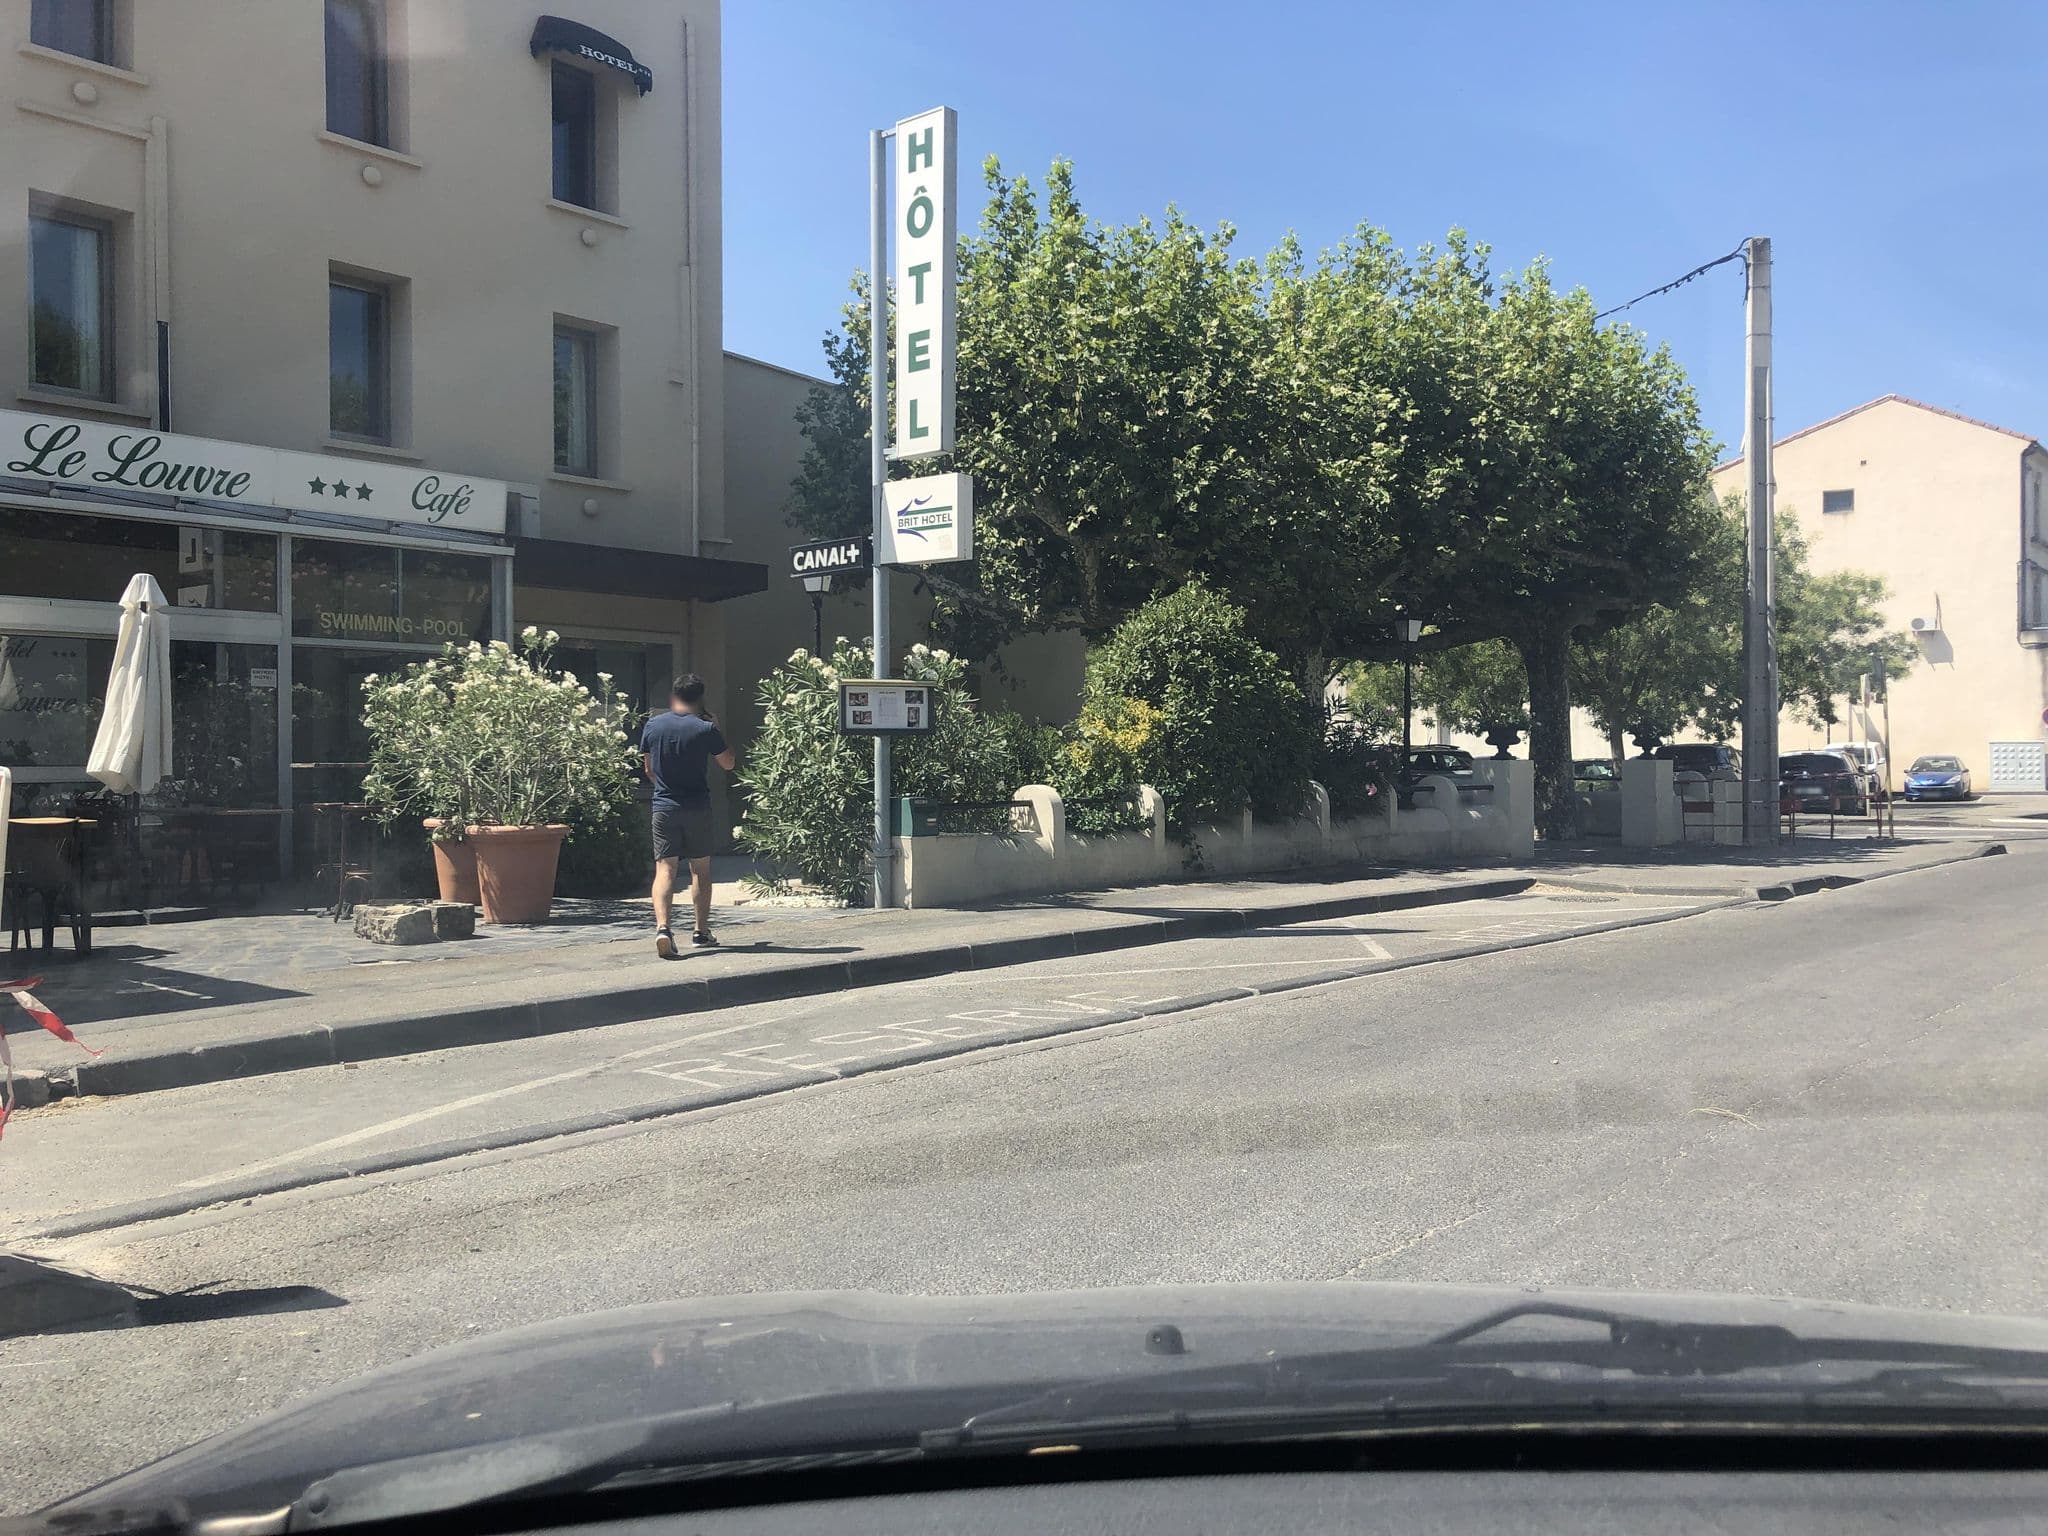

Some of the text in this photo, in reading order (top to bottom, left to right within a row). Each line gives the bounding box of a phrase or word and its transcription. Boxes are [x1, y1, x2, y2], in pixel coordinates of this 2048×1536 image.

[579, 44, 638, 74] HOTEL
[906, 126, 934, 440] HÔTEL
[7, 423, 251, 499] Le Louvre
[411, 475, 475, 524] Café
[898, 512, 953, 528] BRIT HOTEL
[793, 543, 860, 571] CANAL+
[319, 611, 470, 638] SWIMMING-POOL
